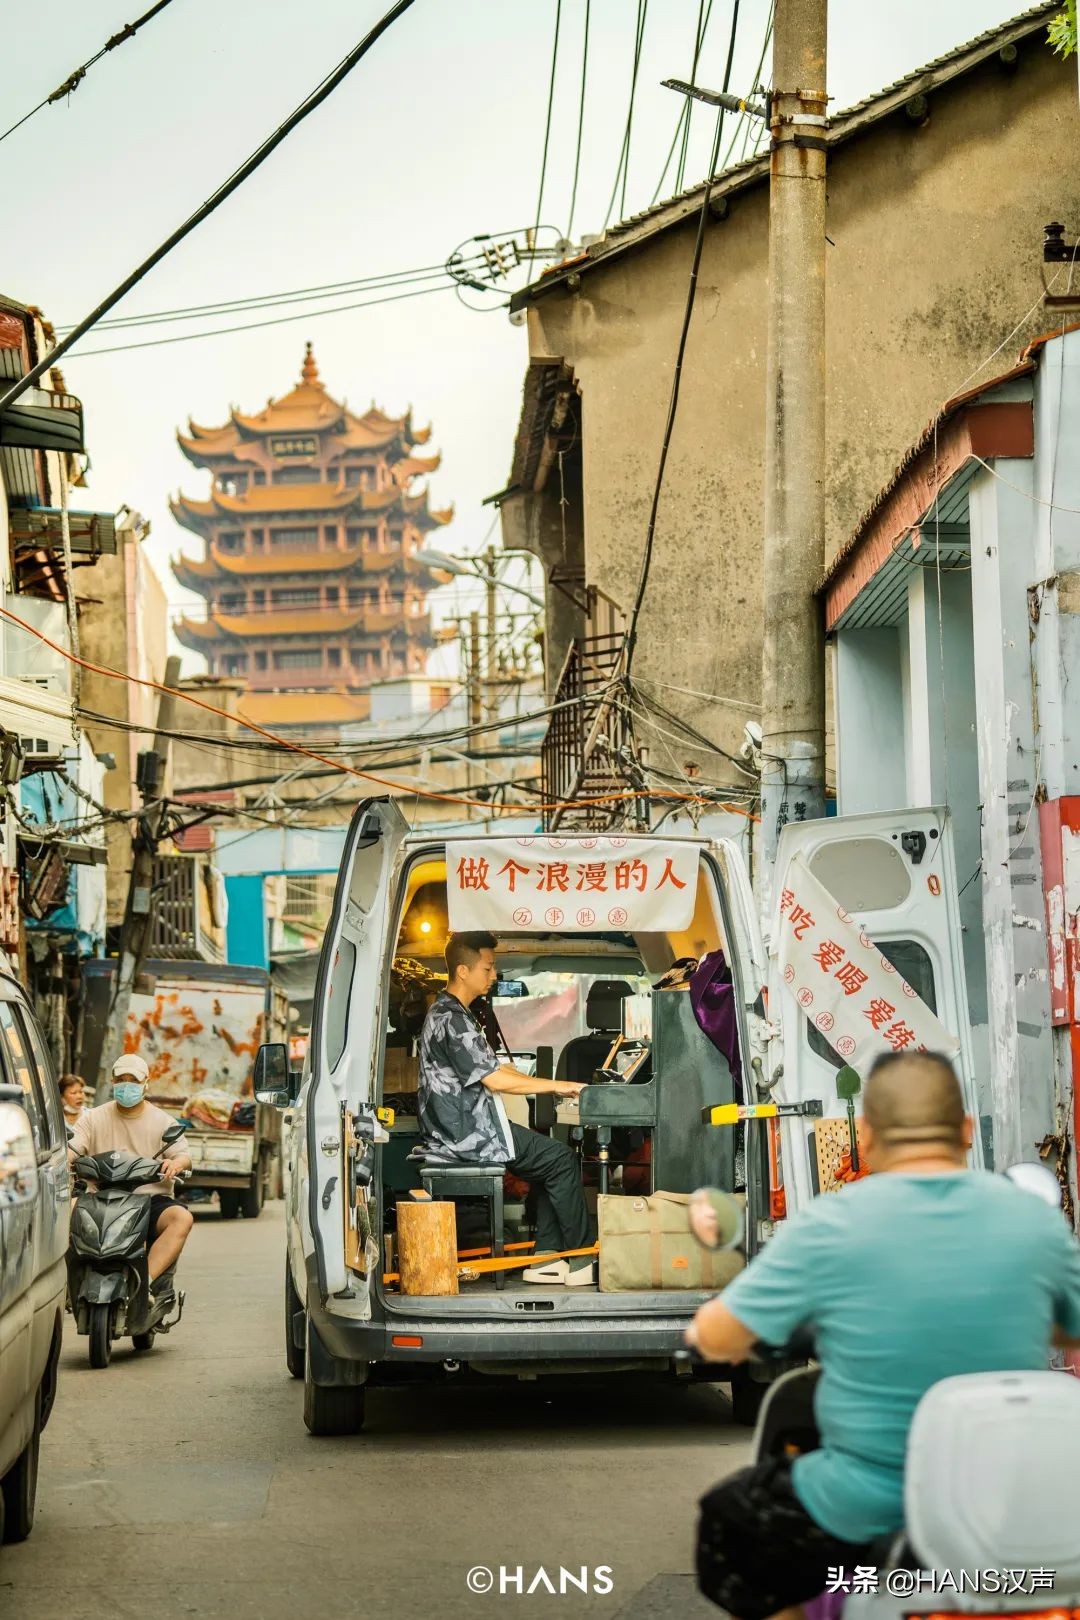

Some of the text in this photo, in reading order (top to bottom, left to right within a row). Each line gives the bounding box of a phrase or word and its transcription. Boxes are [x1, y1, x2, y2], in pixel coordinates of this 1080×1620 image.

[456, 856, 687, 892] 做个浪漫的人
[515, 908, 626, 925] 万事胜意
[811, 938, 869, 996] 爱喝
[862, 996, 929, 1053] 爱练
